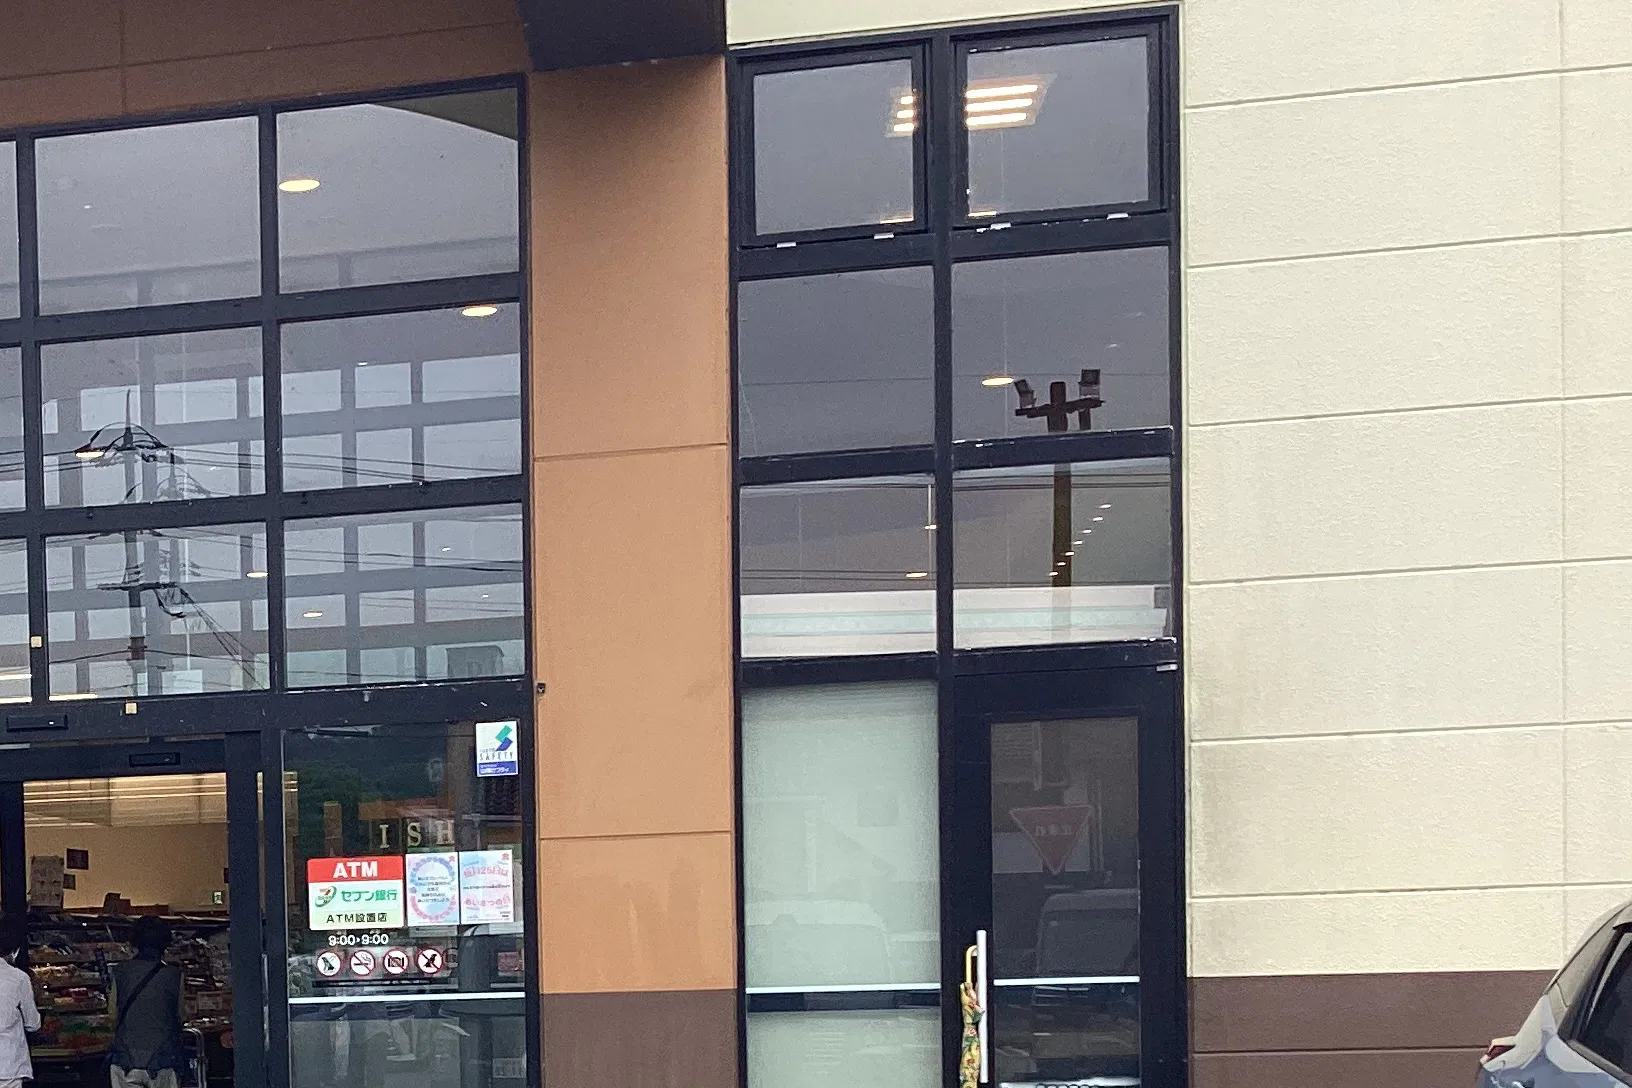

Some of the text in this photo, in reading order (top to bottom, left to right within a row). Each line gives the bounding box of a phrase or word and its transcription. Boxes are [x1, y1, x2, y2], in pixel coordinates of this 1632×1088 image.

[333, 861, 378, 878] ATM
[341, 889, 397, 902] セブン銀行
[326, 913, 387, 923] ATM設置店
